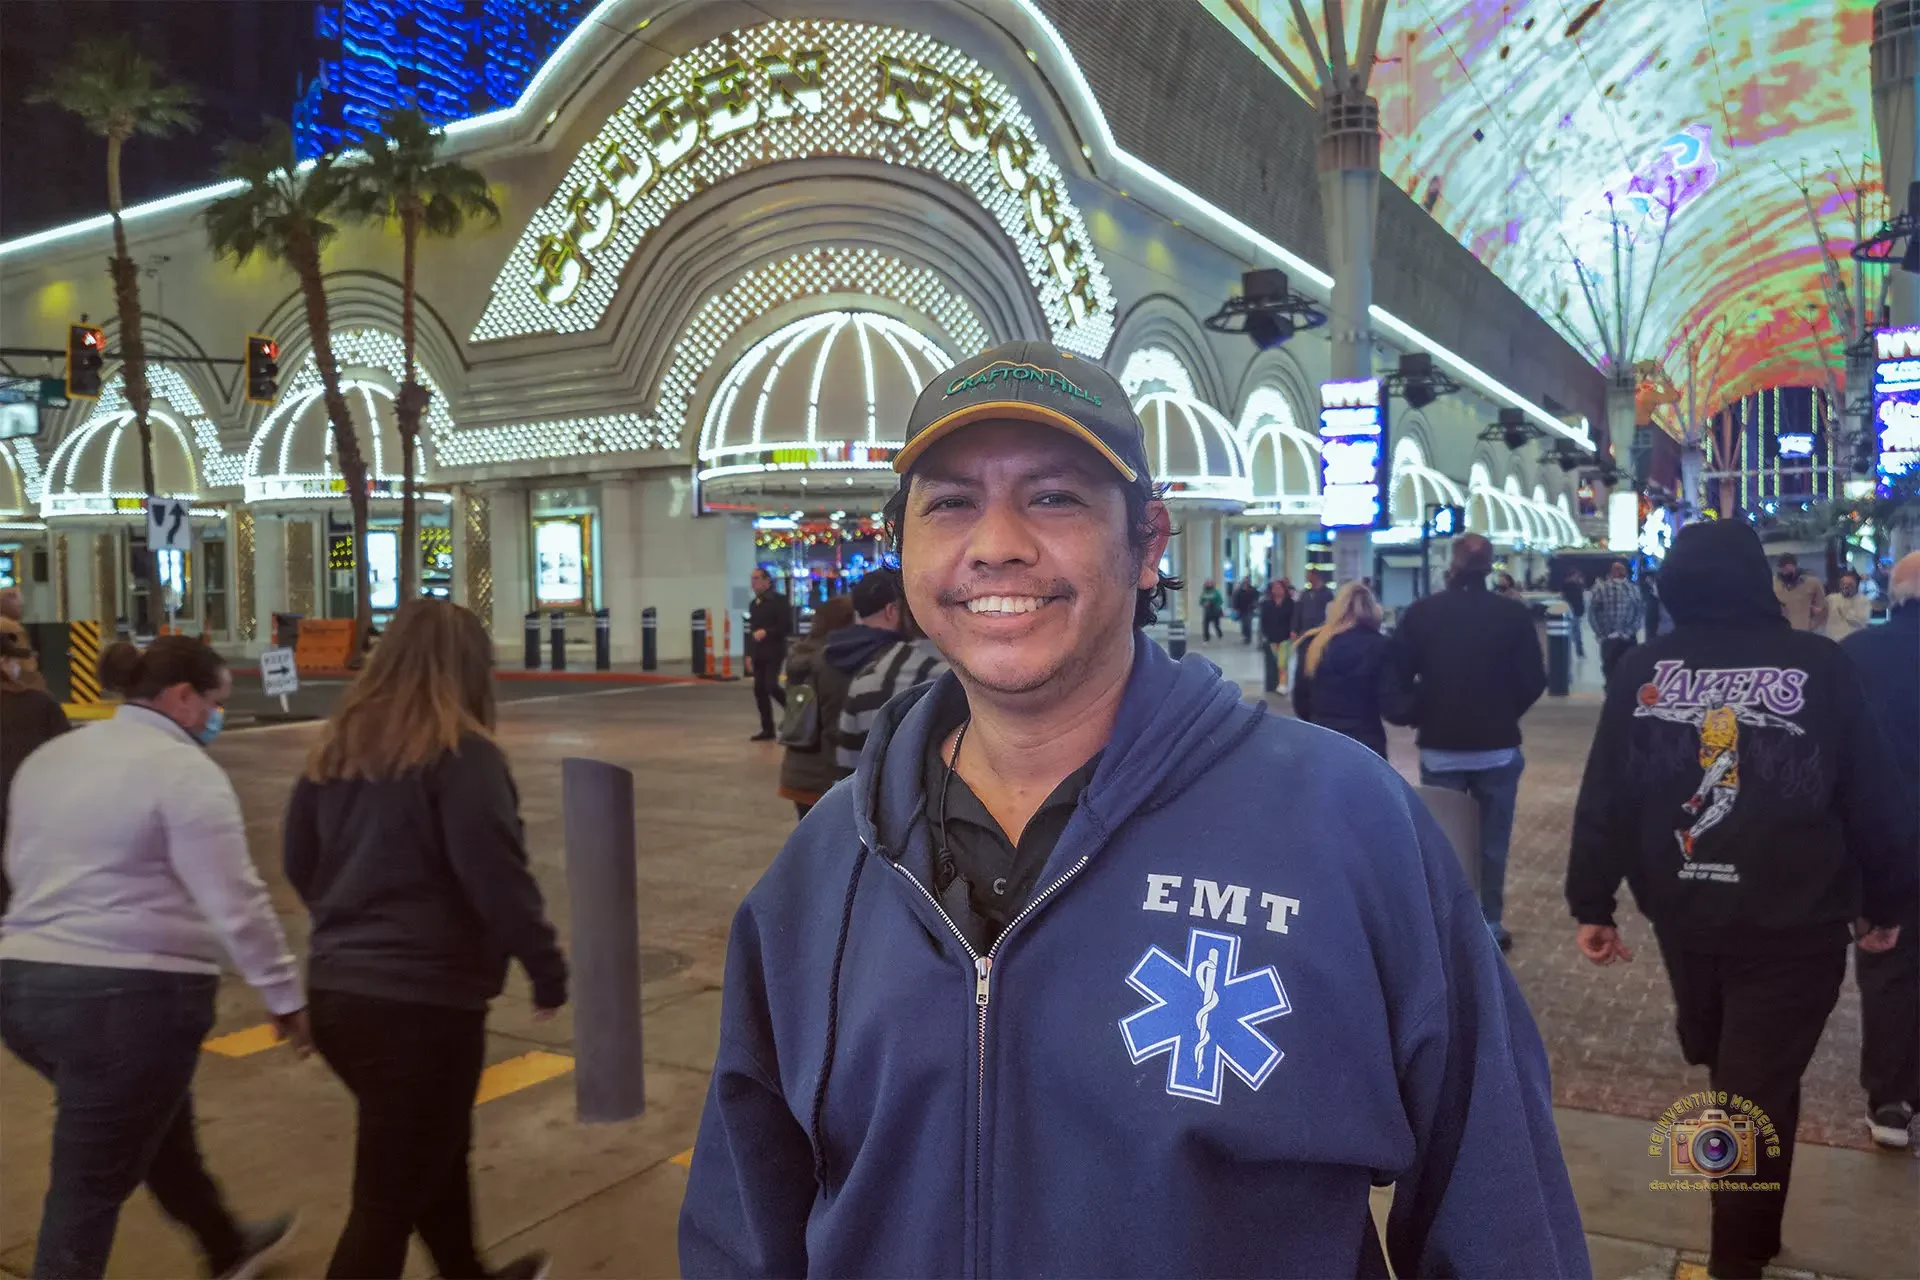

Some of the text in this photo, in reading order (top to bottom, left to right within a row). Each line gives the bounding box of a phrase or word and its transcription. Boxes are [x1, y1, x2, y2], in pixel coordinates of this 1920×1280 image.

[532, 49, 826, 305] GOLDEN
[946, 368, 1044, 395] CRAFTON
[1049, 374, 1102, 407] HILLS
[1652, 660, 1808, 715] LAKERS
[1142, 873, 1300, 935] EMT
